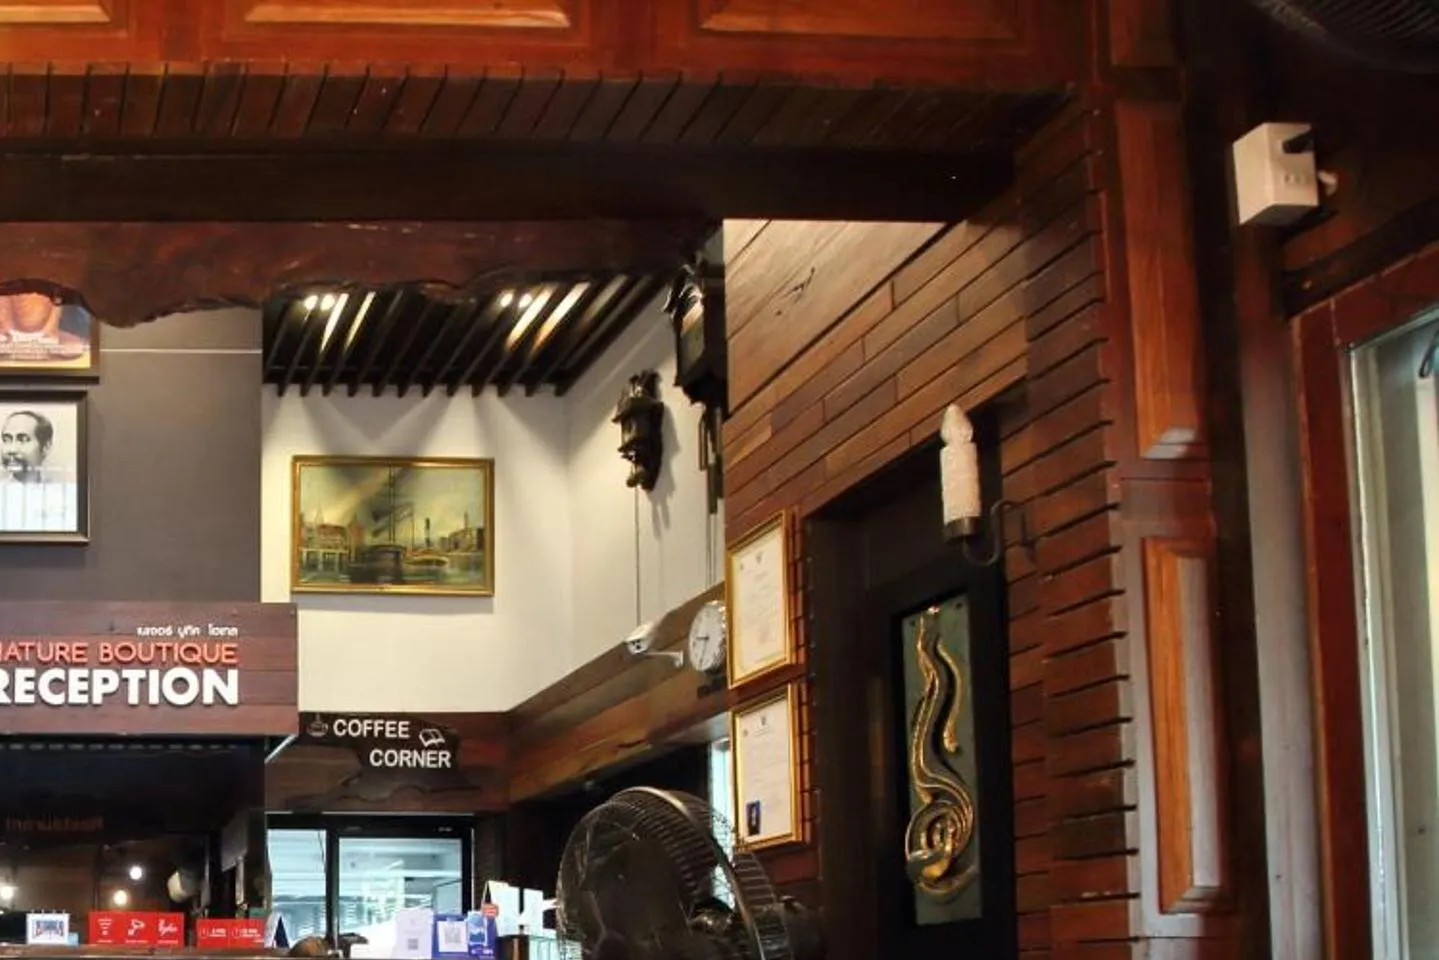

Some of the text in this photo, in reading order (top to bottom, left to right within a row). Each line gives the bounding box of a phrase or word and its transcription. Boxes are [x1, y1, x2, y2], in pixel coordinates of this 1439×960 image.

[99, 641, 239, 664] BOUTIQUE
[333, 719, 410, 738] COFFEE
[369, 749, 451, 768] CORNER
